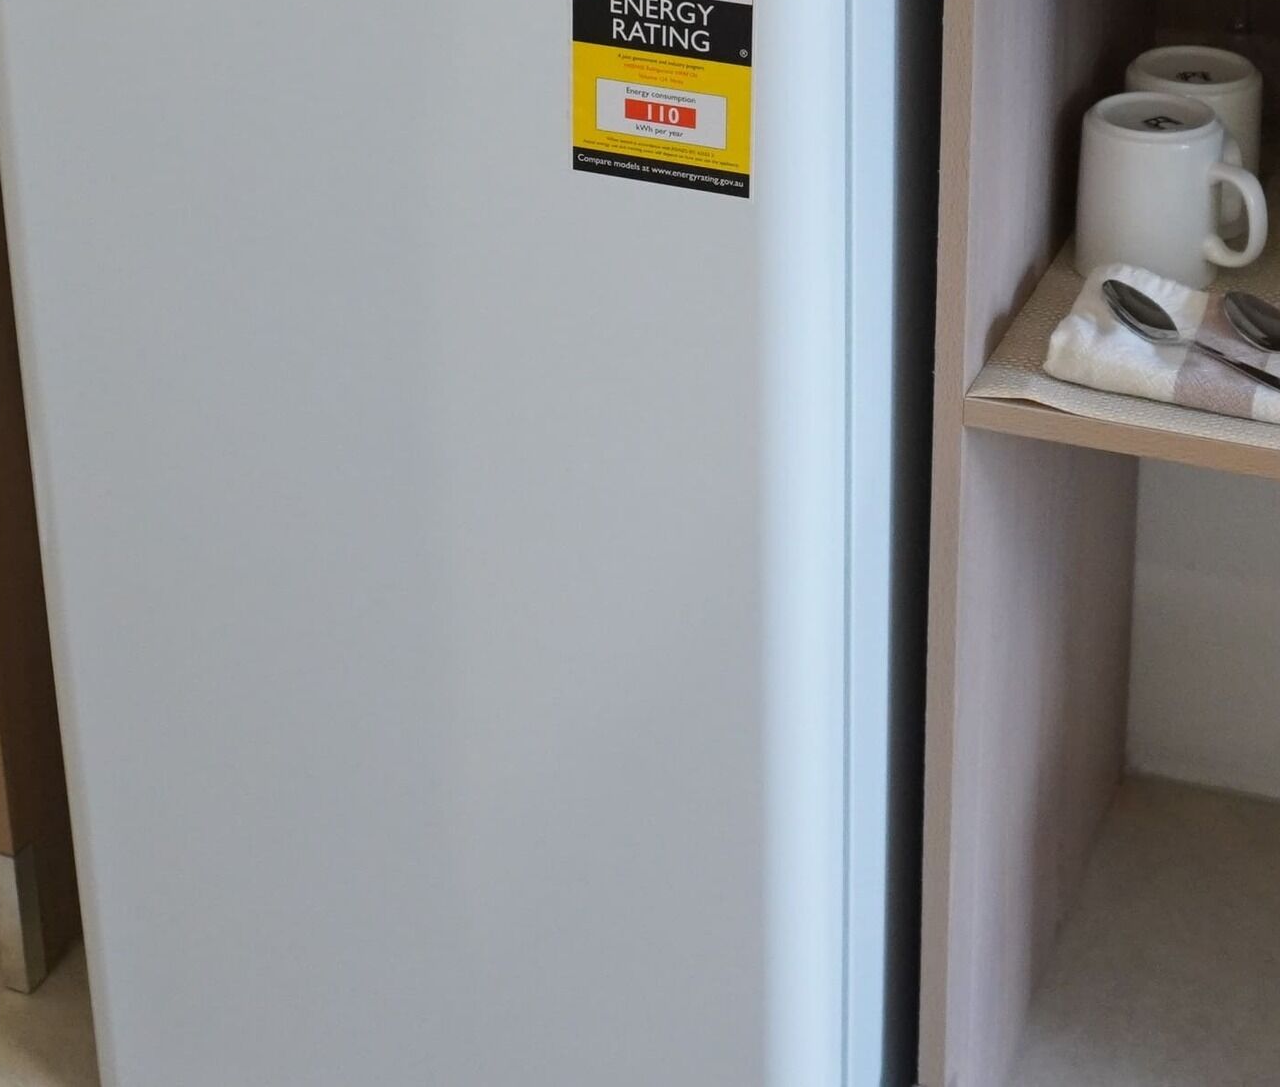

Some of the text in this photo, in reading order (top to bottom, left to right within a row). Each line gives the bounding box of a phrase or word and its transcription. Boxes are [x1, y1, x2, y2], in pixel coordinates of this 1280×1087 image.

[612, 17, 711, 53] RATING
[625, 86, 697, 104] Energy consumption
[647, 103, 680, 124] 110
[635, 123, 684, 138] kWh per year
[577, 153, 612, 167] Compare
[613, 159, 641, 172] models
[641, 164, 651, 174] at
[651, 166, 745, 188] www.energyrating.gov.au
